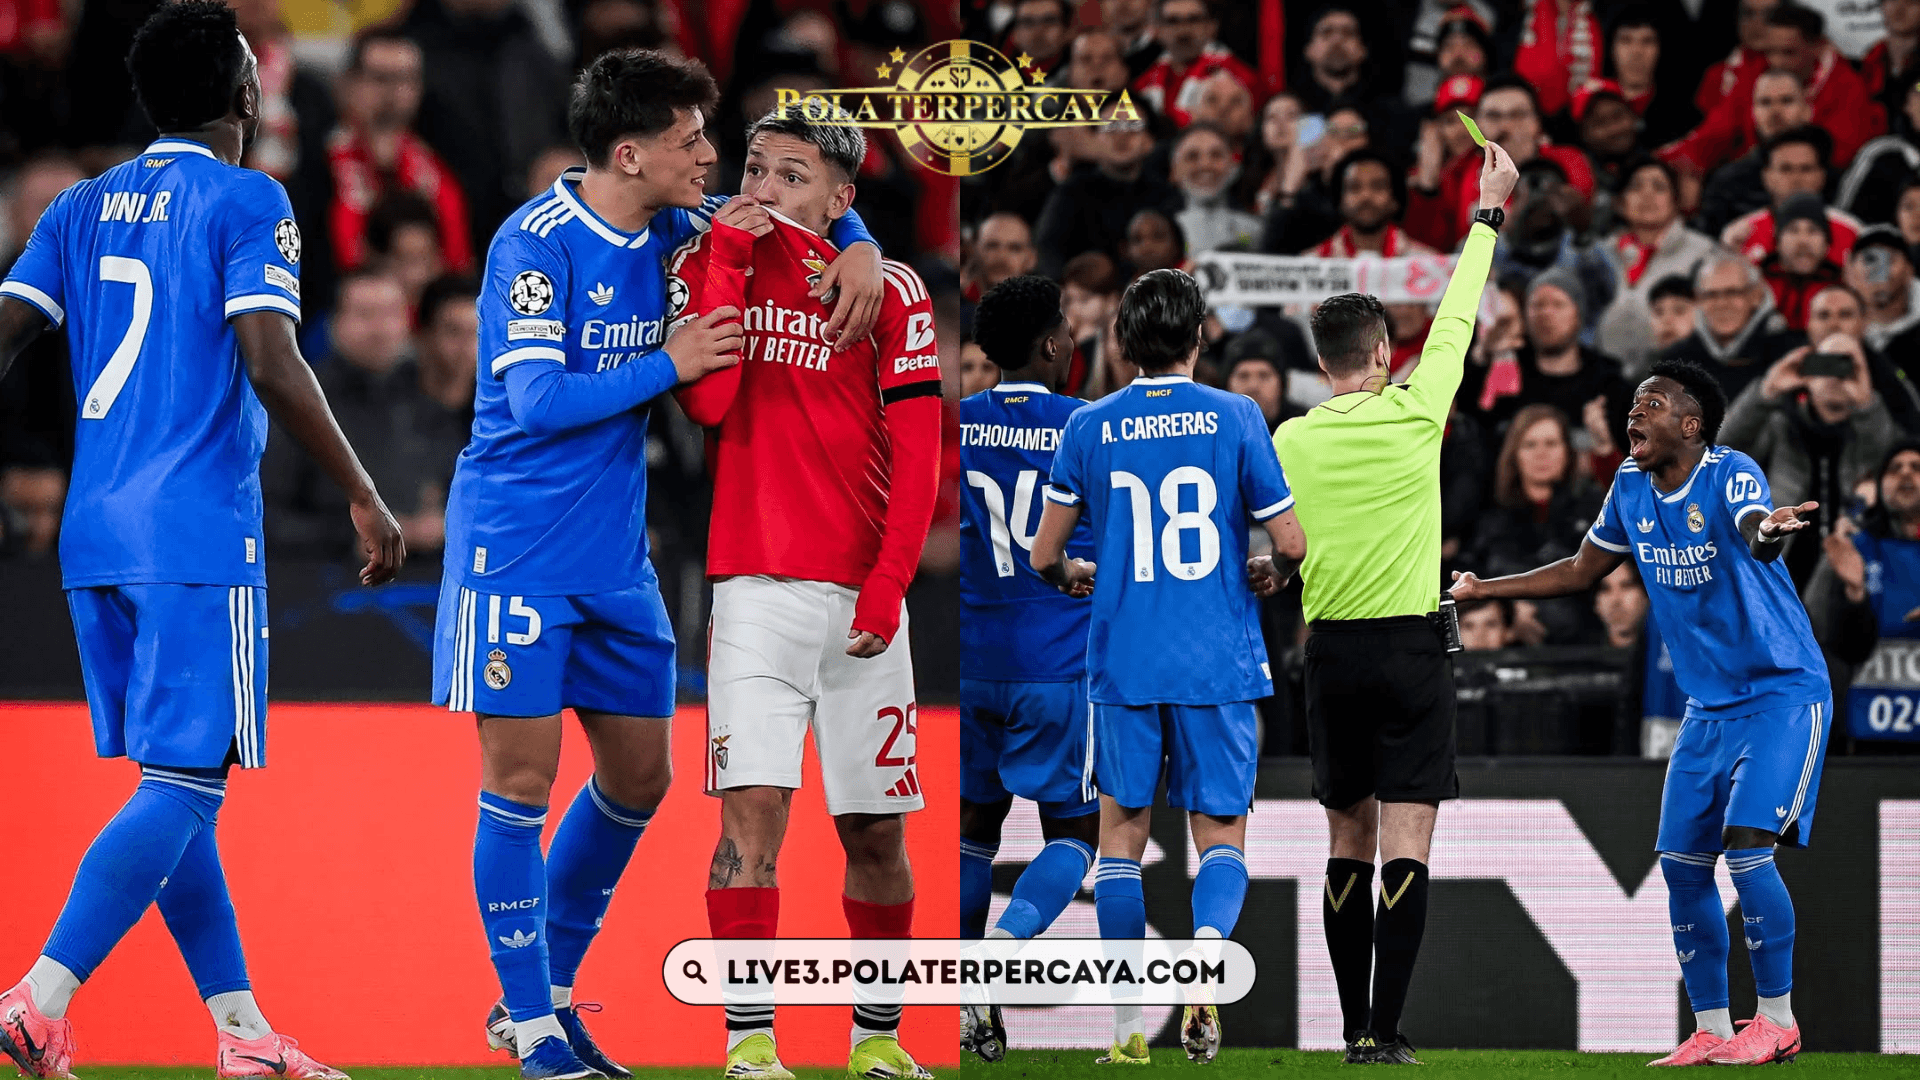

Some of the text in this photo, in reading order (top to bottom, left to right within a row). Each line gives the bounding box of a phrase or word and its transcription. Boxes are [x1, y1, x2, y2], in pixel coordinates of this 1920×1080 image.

[145, 157, 176, 169] RMC
[142, 190, 169, 223] JR.
[519, 283, 543, 303] 15
[82, 255, 153, 419] 7
[581, 314, 665, 349] Emirat
[763, 336, 831, 372] BETTER
[1004, 396, 1029, 404] RMCF
[1146, 389, 1172, 397] RMCF
[960, 423, 1065, 451] TCHOUAMEN
[1102, 411, 1218, 444] A. CARRERAS
[1729, 472, 1760, 503] hp
[966, 470, 1054, 577] 14
[1110, 466, 1220, 582] 18
[1636, 541, 1717, 566] Emirates
[1656, 565, 1713, 586] FLY BETTER
[488, 595, 541, 645] 15
[875, 701, 916, 767] 25
[488, 898, 540, 913] RMCF
